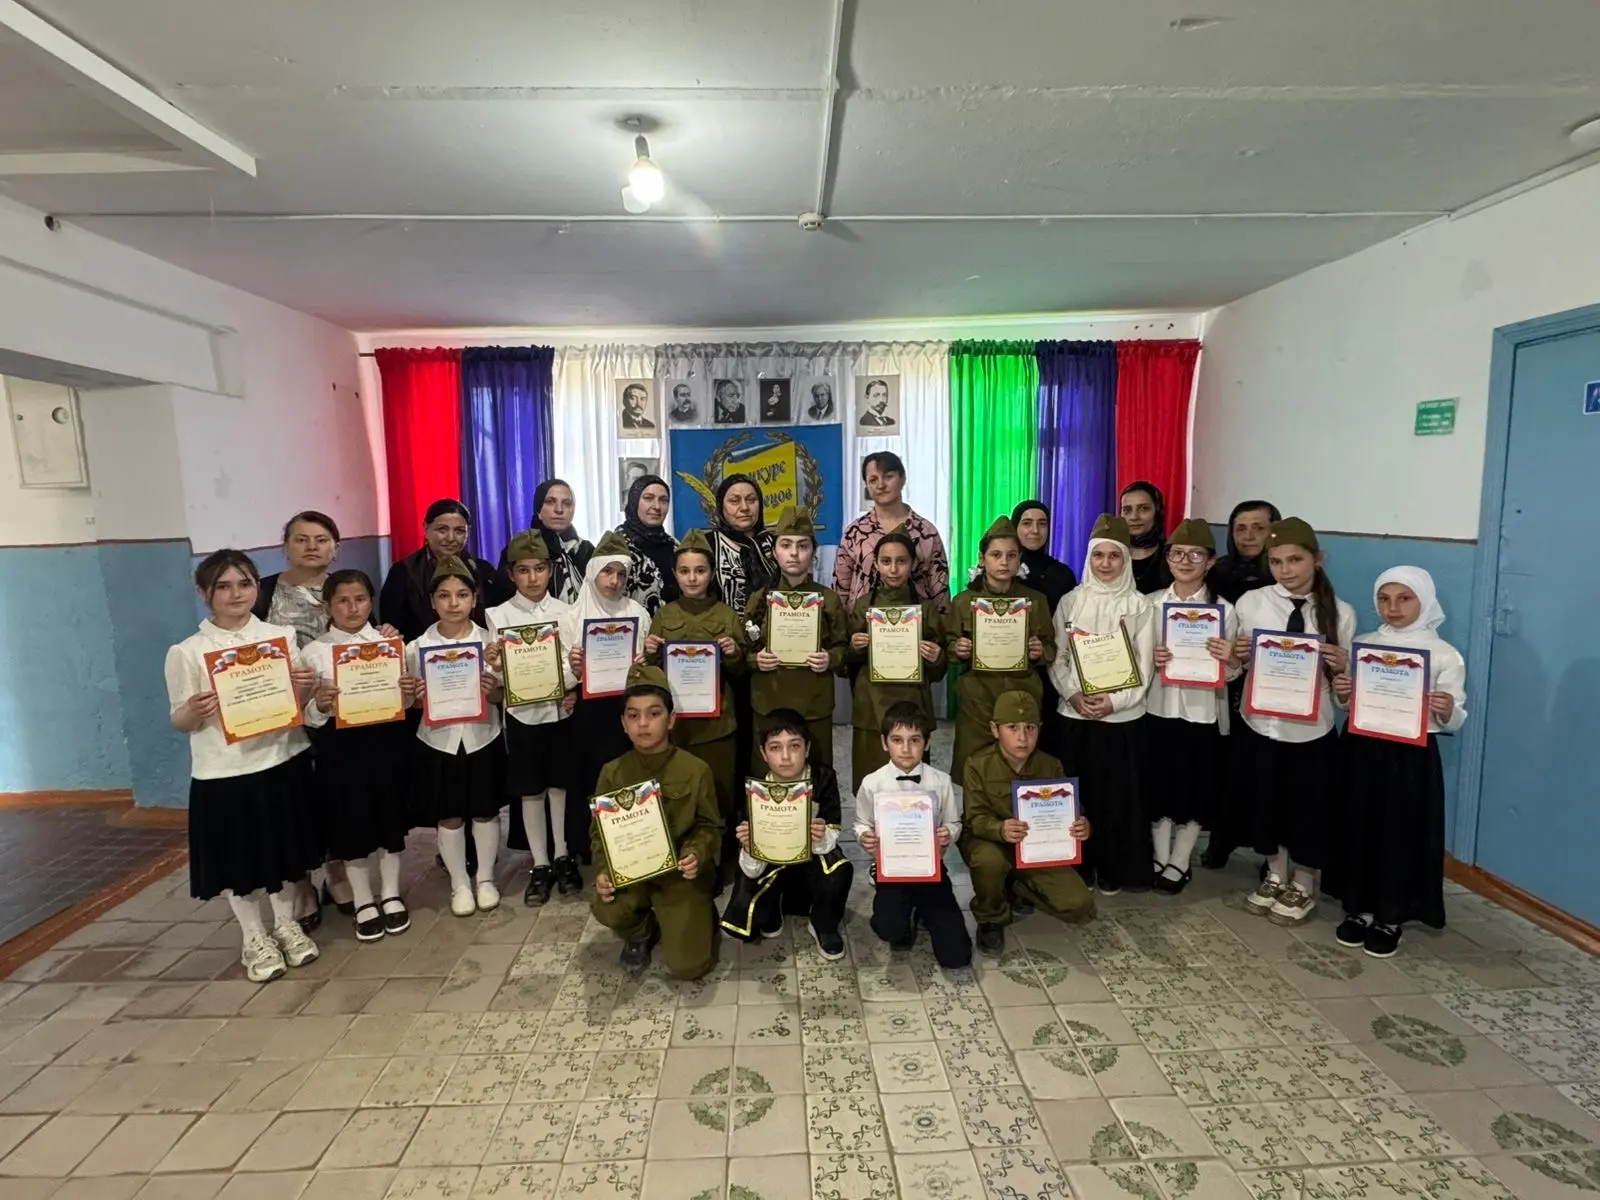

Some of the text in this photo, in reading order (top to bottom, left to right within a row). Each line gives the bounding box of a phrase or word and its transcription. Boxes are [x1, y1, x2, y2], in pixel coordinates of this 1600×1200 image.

[1178, 622, 1208, 630] ГРАМОТА
[1083, 635, 1115, 646] ГРАМОТА
[514, 646, 547, 655] ГРАМОТА
[1269, 651, 1305, 660] ГРАМОТА
[230, 663, 272, 678] ГРАМОТА
[349, 661, 388, 671] ГРАМОТА
[437, 662, 469, 670] ГРАМОТА
[1371, 666, 1409, 677] ГРАМОТА
[760, 804, 797, 812] ГРАМОТА
[1030, 800, 1063, 808] ГРАМОТА
[611, 808, 650, 825] ГРАМОТА
